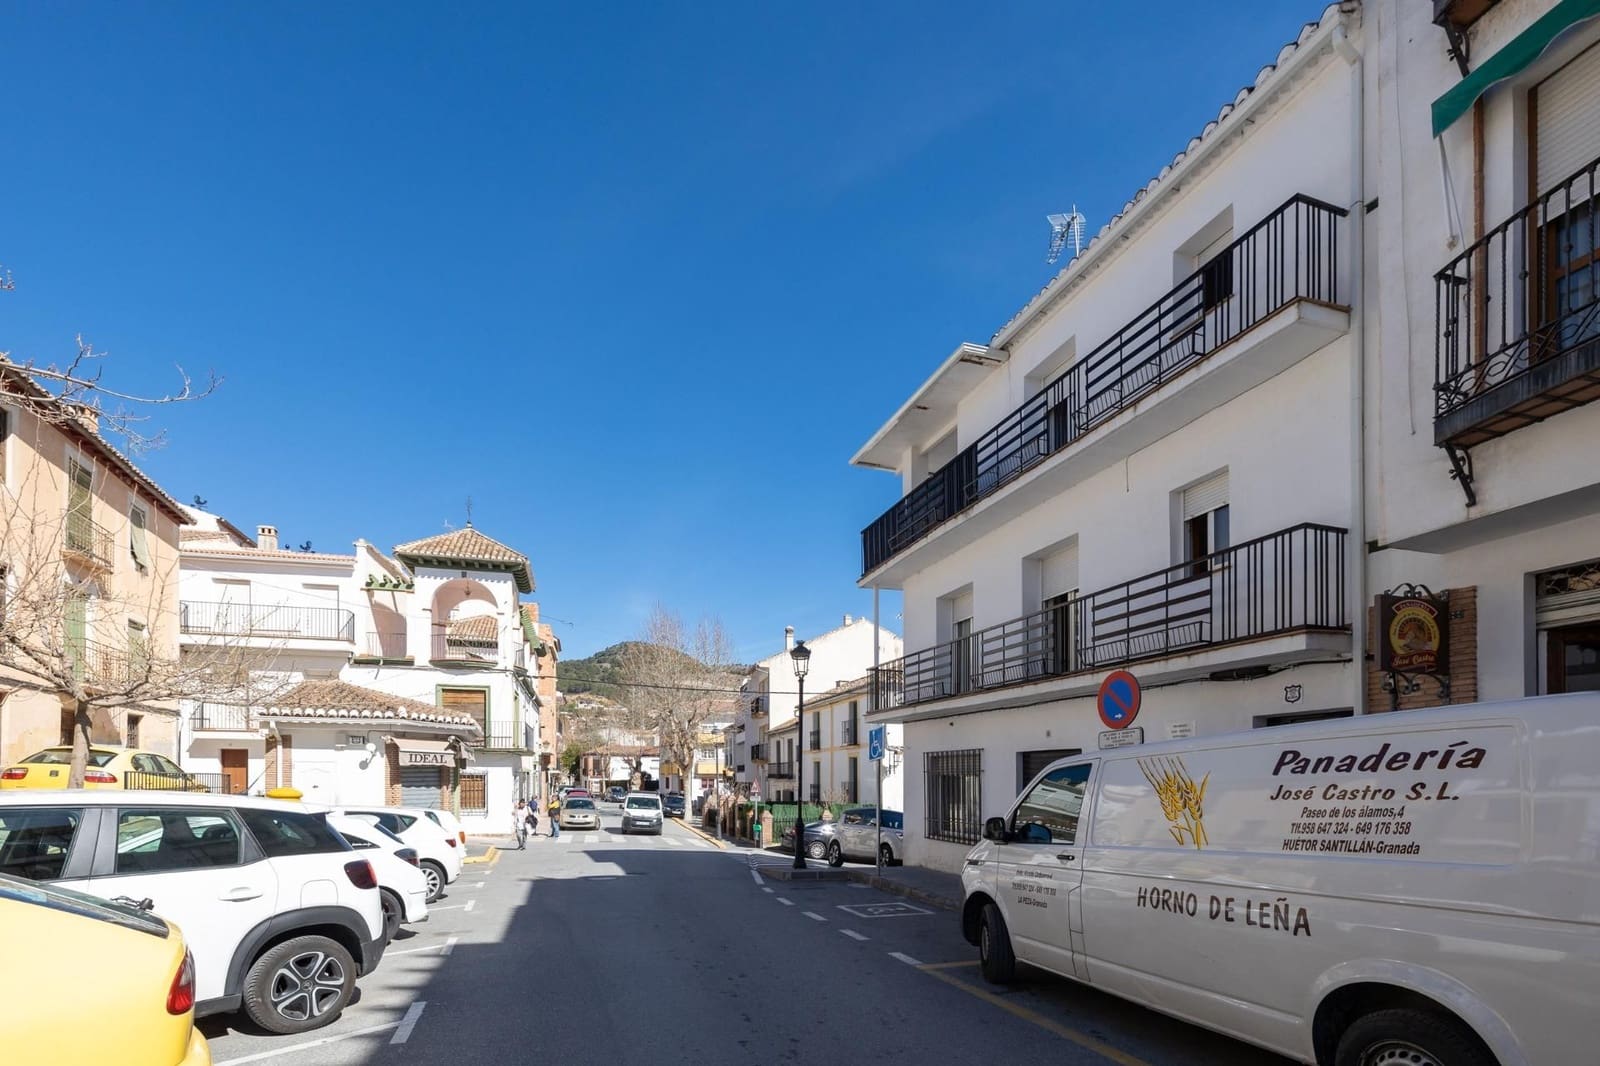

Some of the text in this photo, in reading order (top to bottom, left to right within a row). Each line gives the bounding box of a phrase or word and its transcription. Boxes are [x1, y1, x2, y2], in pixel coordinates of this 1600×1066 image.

[408, 753, 447, 764] IDEAL
[1272, 740, 1487, 776] Panadería
[1270, 781, 1460, 801] José Castro S.L.
[1301, 806, 1327, 818] Paseo
[1329, 807, 1340, 818] de
[1342, 806, 1357, 818] los
[1317, 822, 1332, 835] 647
[1333, 822, 1349, 835] 324
[1355, 822, 1372, 835] 649
[1375, 822, 1391, 835] 176
[1393, 821, 1411, 835] 358
[1282, 837, 1317, 852] HUÉTOR
[1137, 886, 1312, 937] HORNO DE LEÑA
